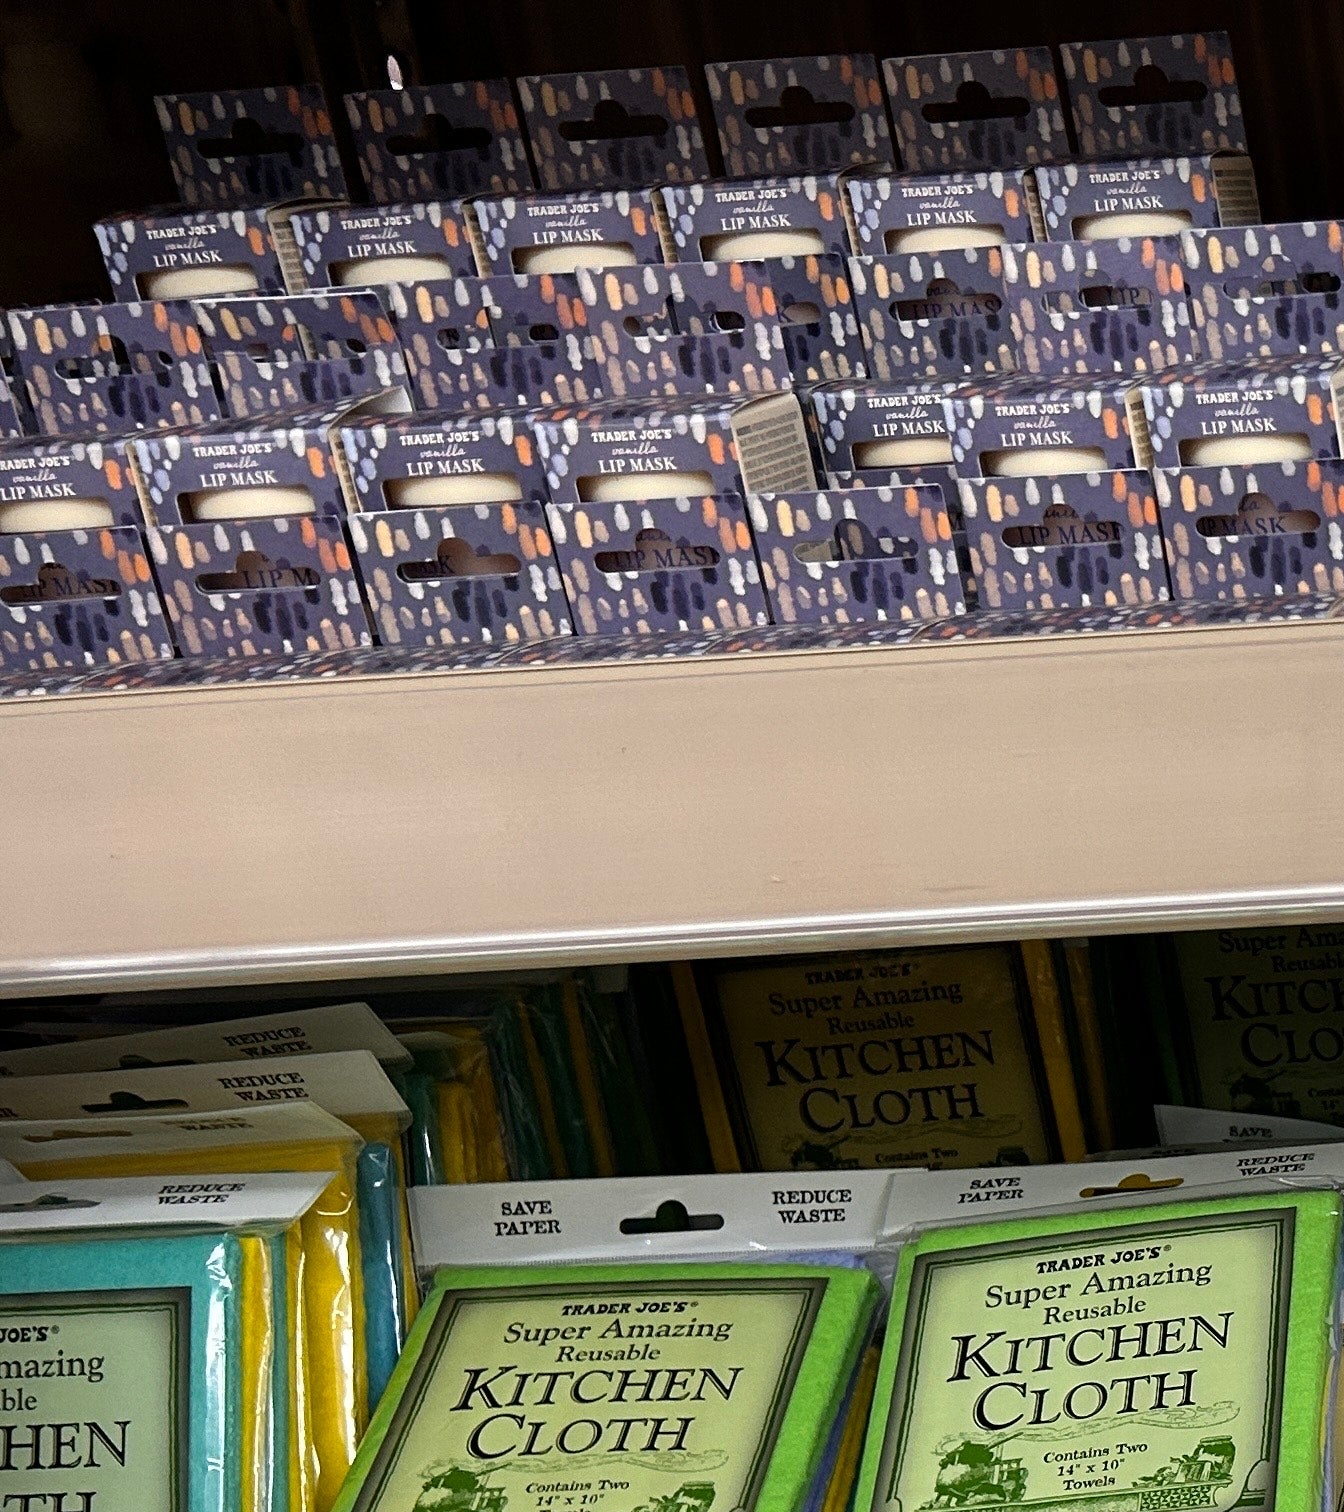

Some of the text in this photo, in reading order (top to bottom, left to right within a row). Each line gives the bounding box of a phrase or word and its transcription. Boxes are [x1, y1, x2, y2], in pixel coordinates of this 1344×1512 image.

[193, 445, 237, 457] TRADER
[214, 456, 259, 469] vanilla
[200, 470, 278, 487] LIP MASK
[969, 1177, 1021, 1190] SAVE
[958, 1189, 1024, 1204] PAPER
[1036, 1254, 1106, 1274] TRADER
[985, 1264, 1212, 1308] Super Amazing
[1043, 1296, 1147, 1326] Reusable
[946, 1312, 1234, 1382] KITCHEN
[972, 1369, 1198, 1431] CLOTH
[1043, 1442, 1148, 1464] Contains Two
[1063, 1475, 1116, 1491] Towels
